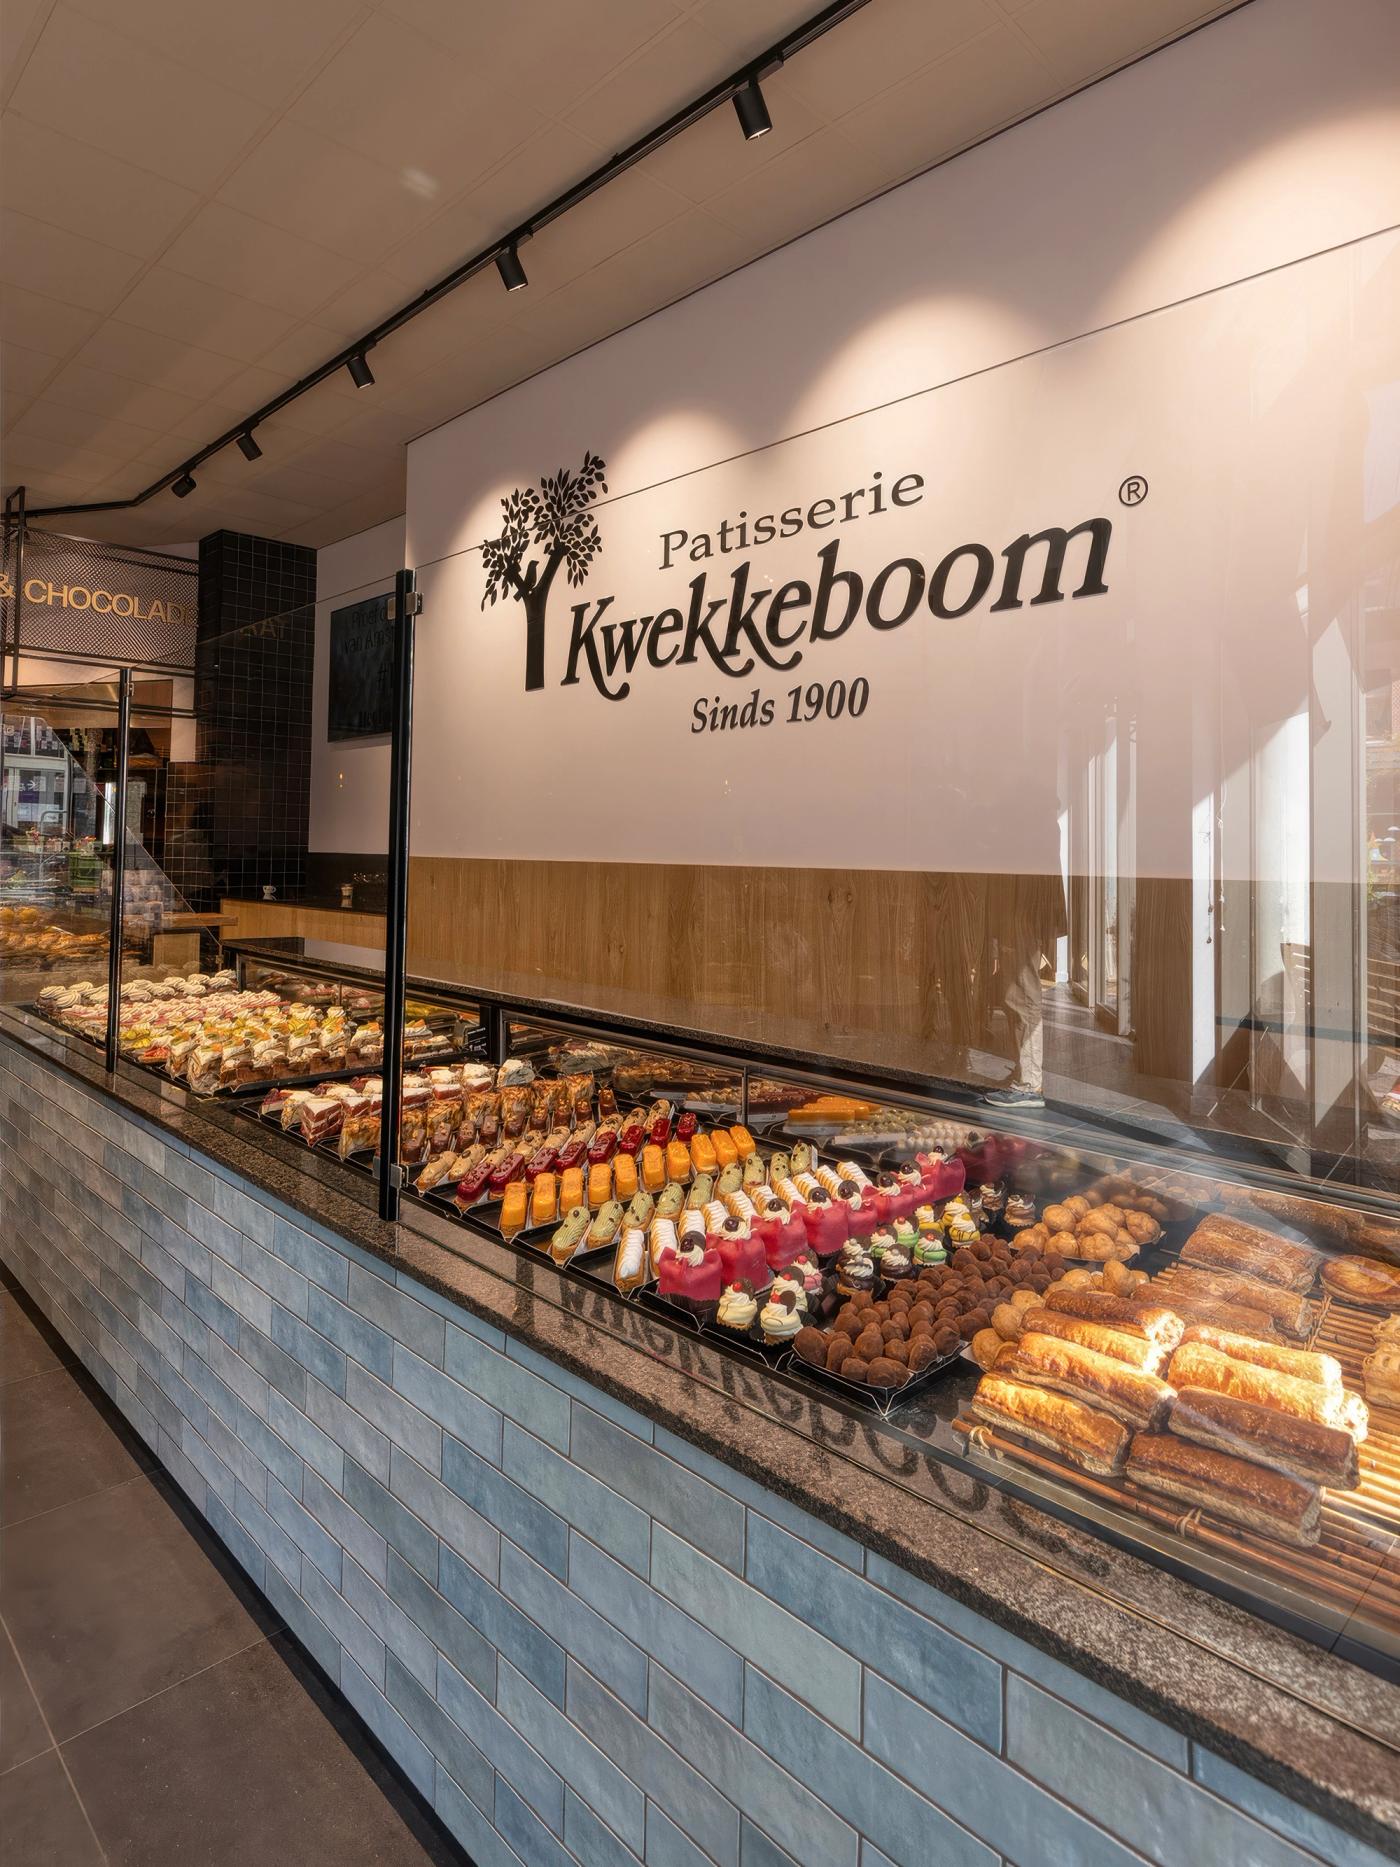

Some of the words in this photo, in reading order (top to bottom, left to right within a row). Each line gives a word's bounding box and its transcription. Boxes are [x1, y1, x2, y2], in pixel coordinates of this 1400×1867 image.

[658, 471, 926, 570] Patisserie
[560, 517, 1113, 702] Kwekkeboom
[691, 687, 775, 735] Sinds
[786, 677, 870, 724] 1900
